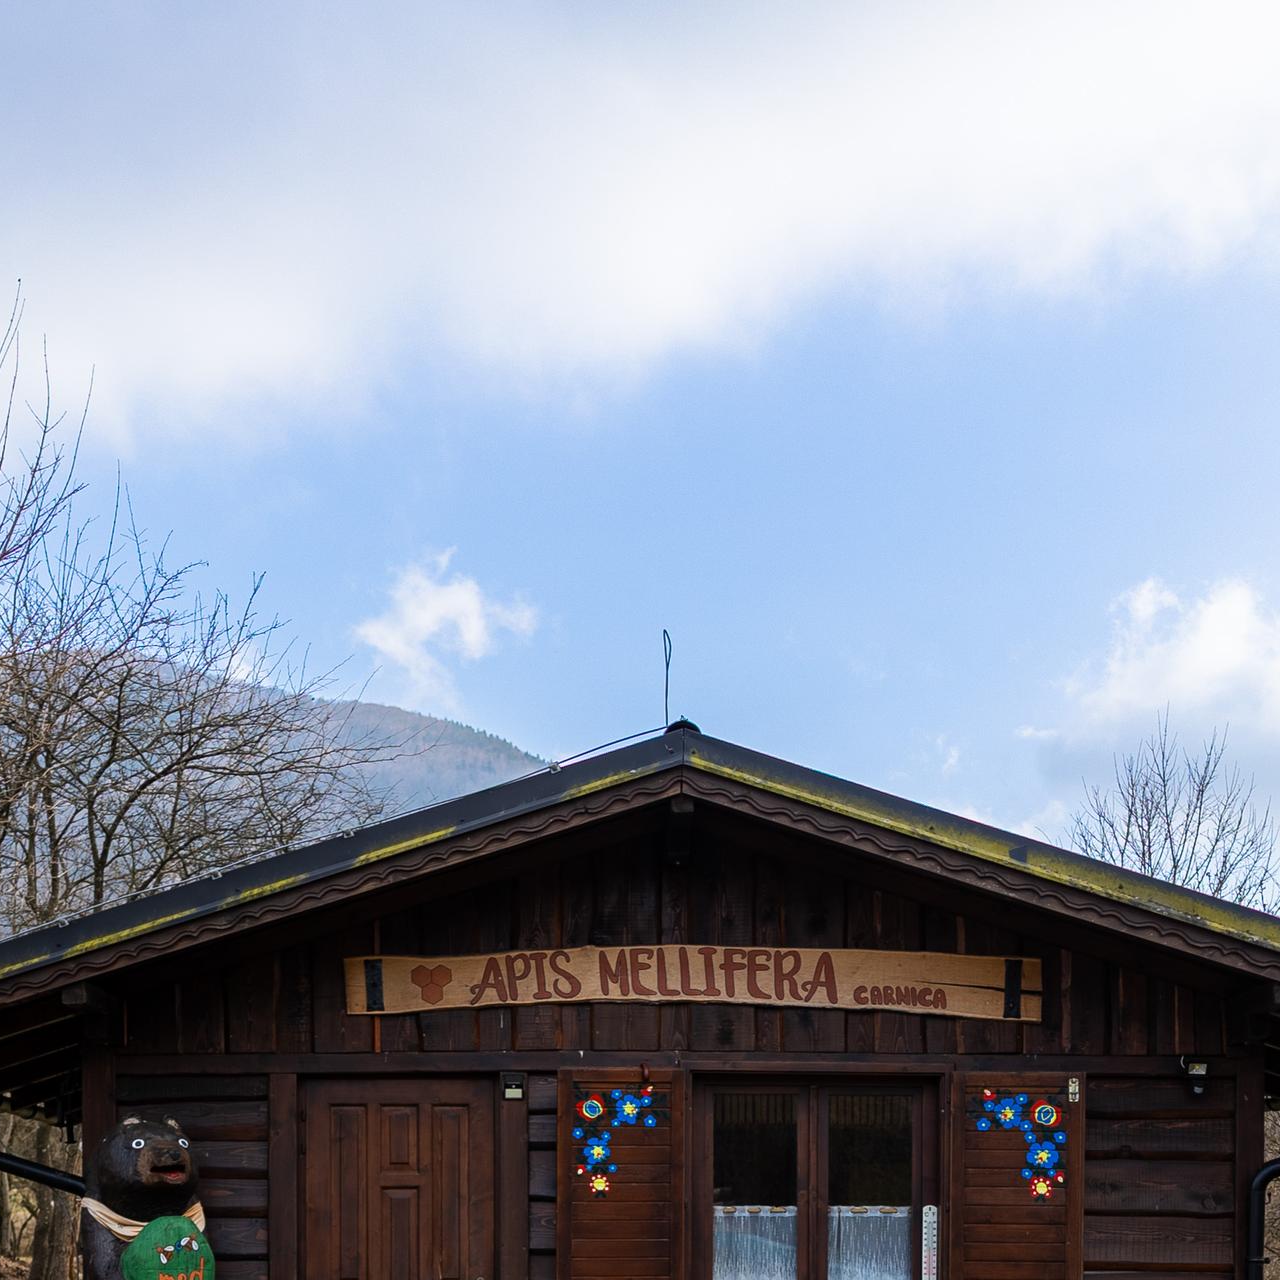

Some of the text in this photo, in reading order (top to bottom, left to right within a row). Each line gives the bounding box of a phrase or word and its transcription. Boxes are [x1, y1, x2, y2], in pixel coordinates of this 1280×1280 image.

[470, 947, 947, 1010] APIS MELLIFERA CARNICA
